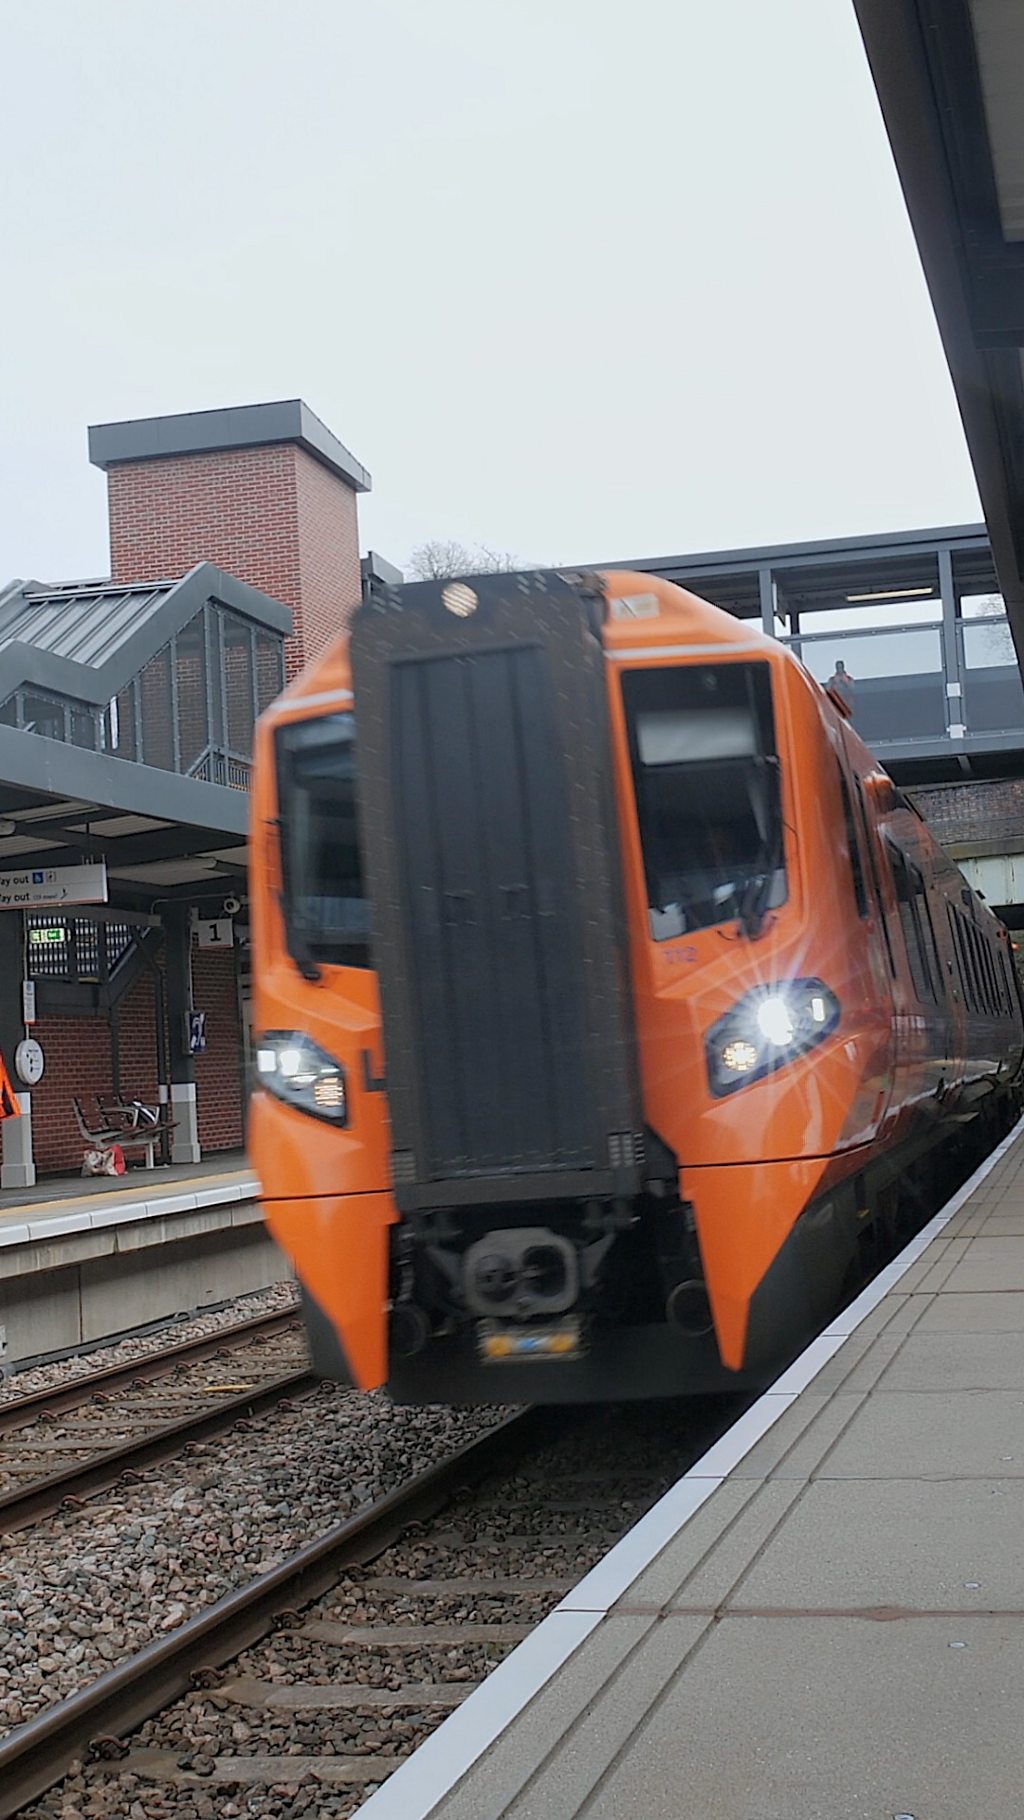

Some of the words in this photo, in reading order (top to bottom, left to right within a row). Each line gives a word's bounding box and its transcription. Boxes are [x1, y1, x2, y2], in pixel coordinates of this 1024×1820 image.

[0, 877, 11, 887] ay
[13, 876, 29, 885] out
[0, 893, 11, 905] ay
[14, 893, 30, 902] out
[209, 923, 222, 942] 1
